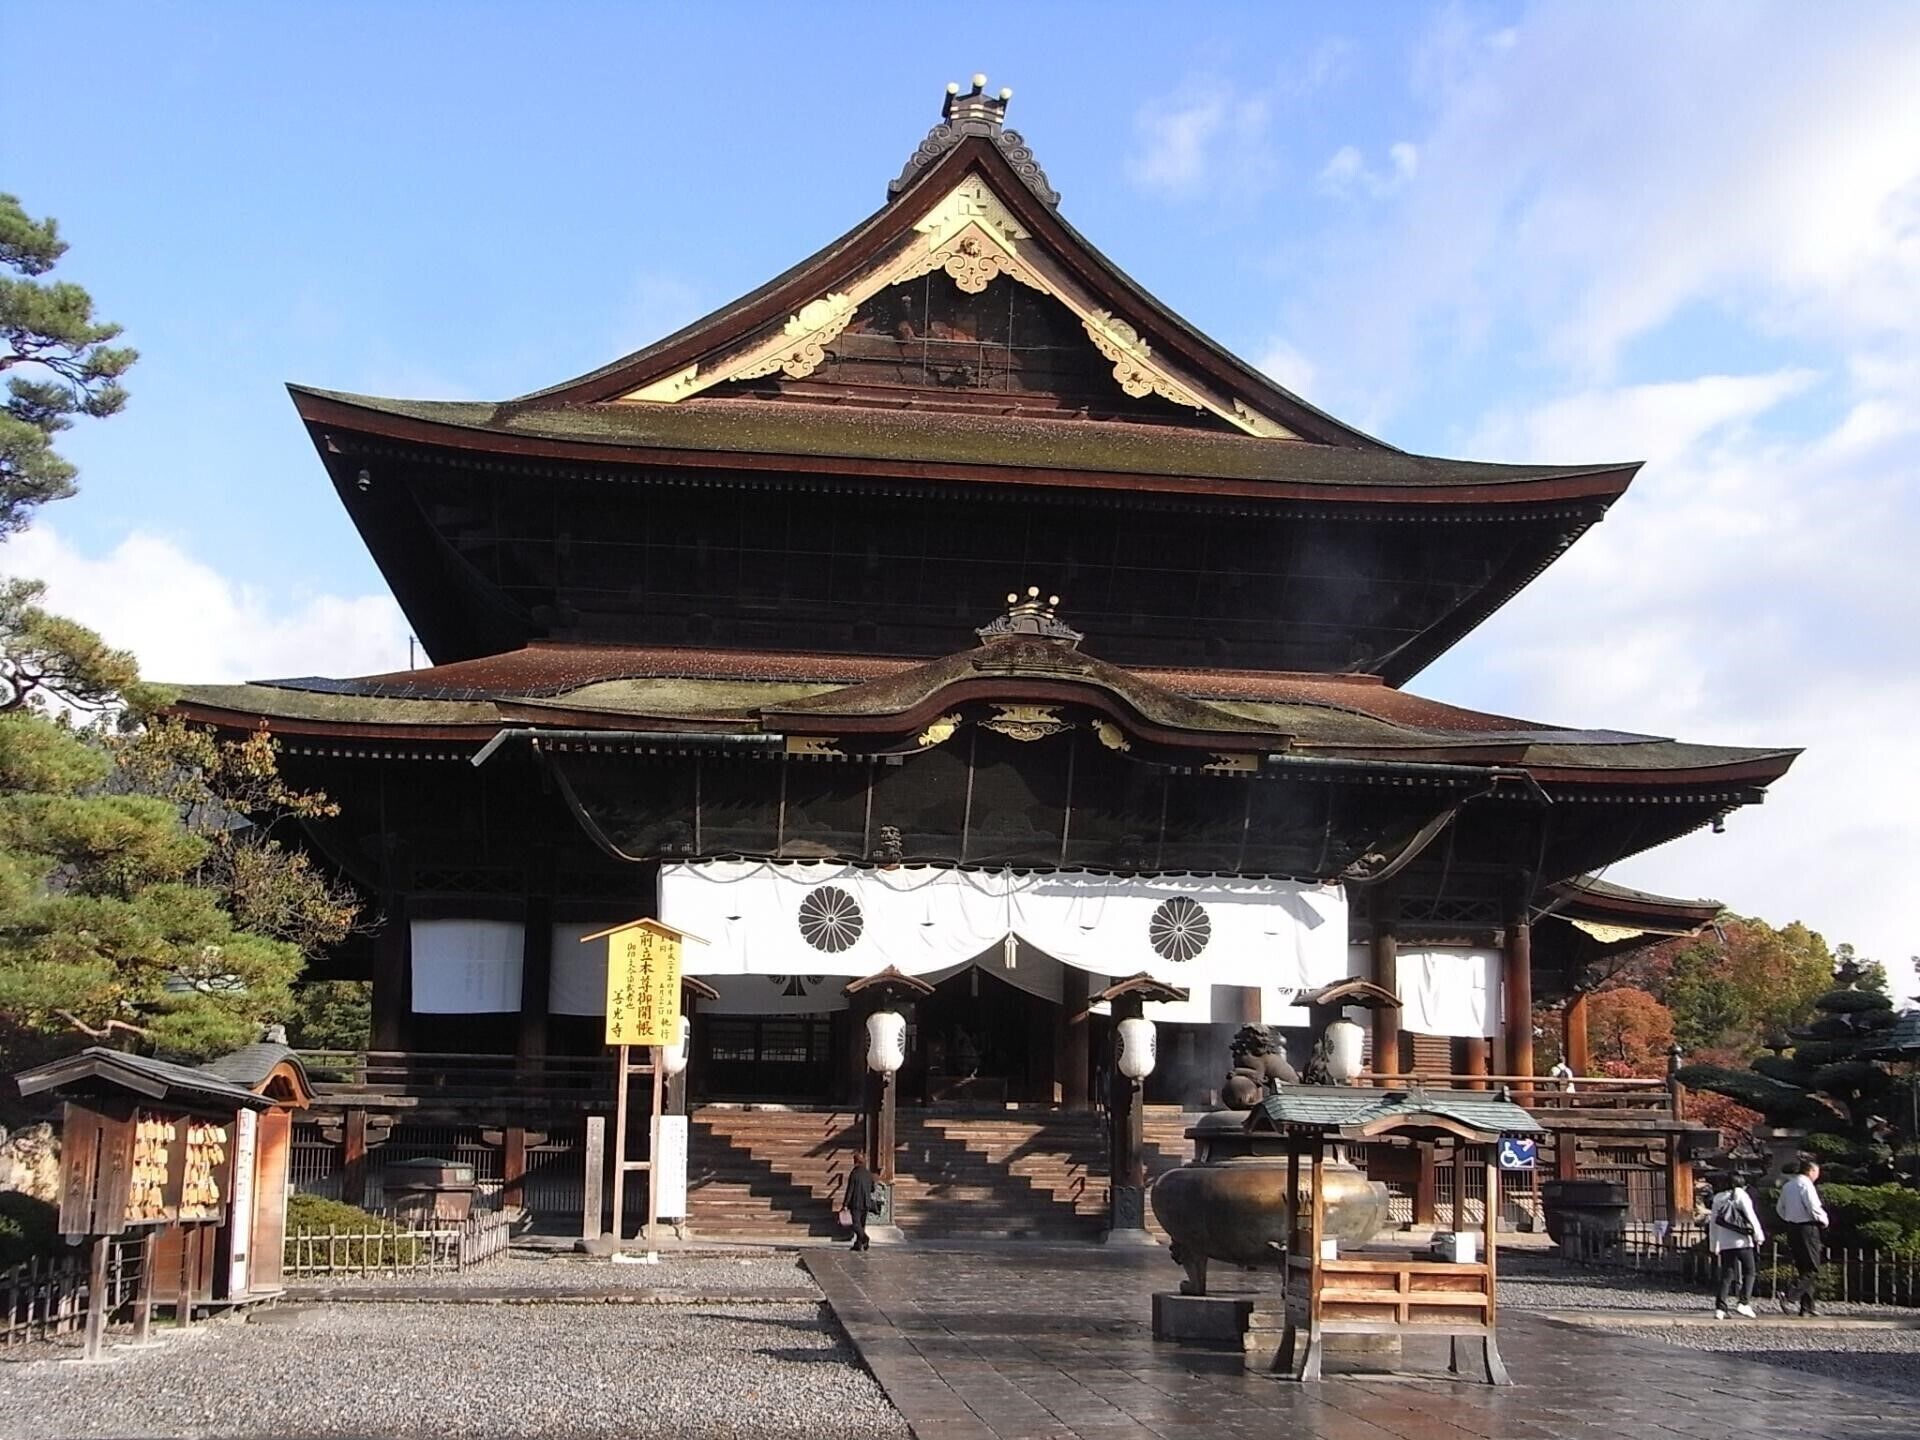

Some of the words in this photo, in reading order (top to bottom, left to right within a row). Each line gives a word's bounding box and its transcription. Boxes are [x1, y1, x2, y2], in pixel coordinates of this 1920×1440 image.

[611, 989, 624, 1038] 善光寺
[636, 930, 654, 1036] 前立本尊御開帳
